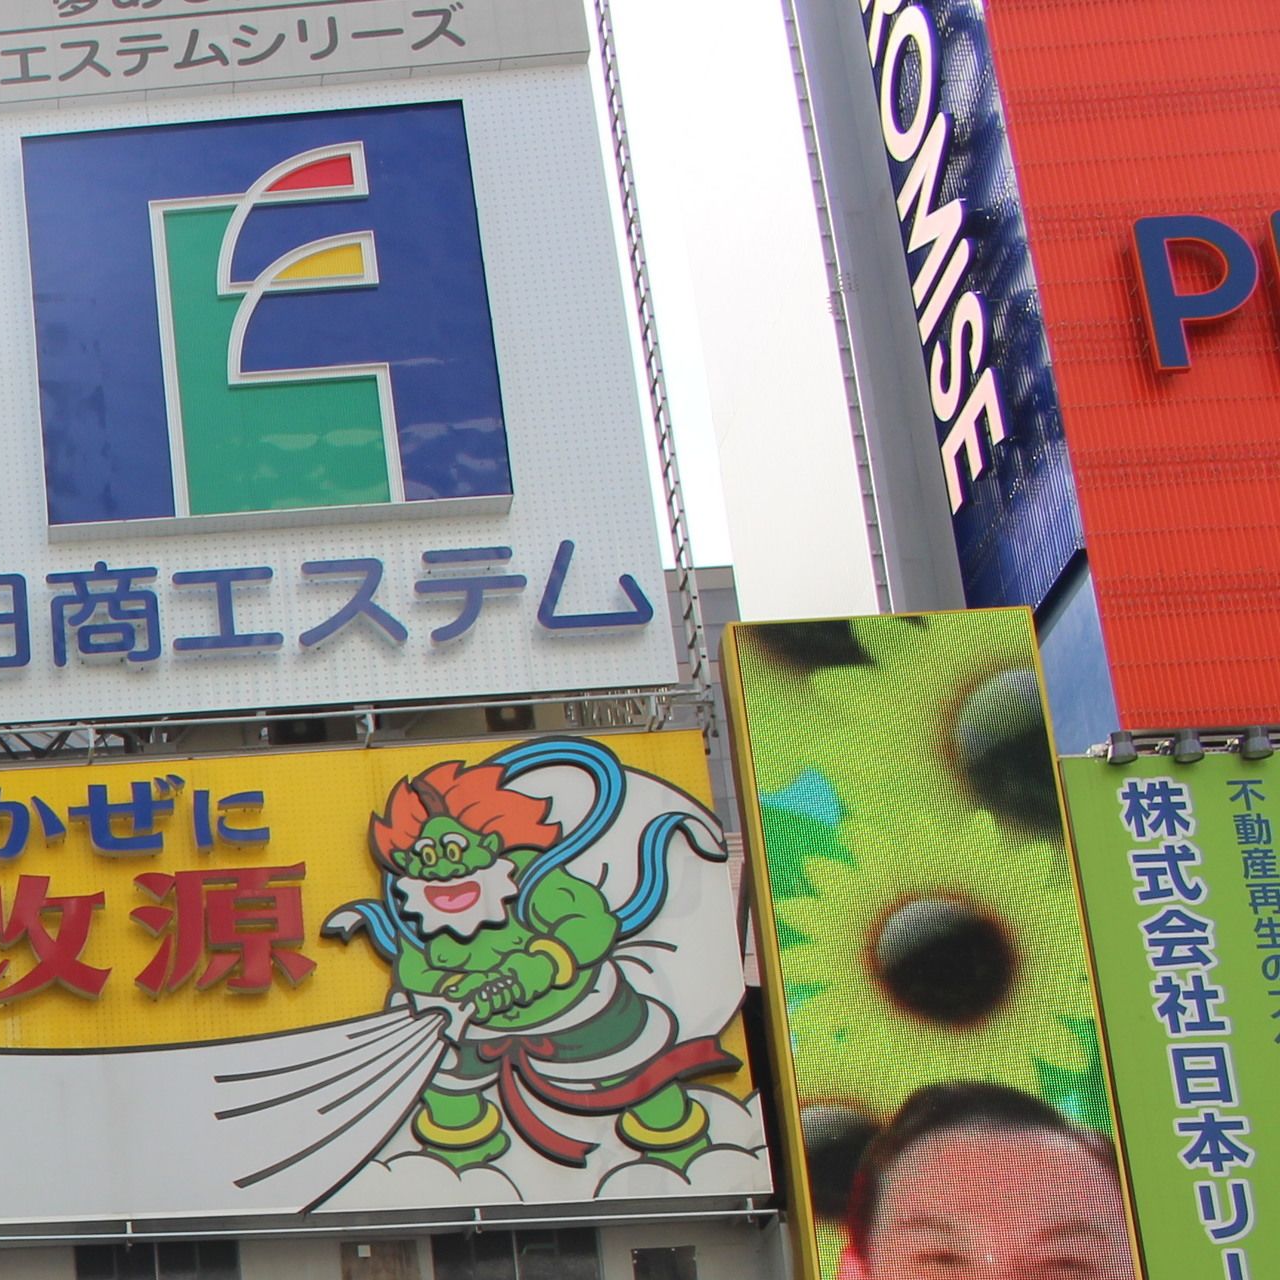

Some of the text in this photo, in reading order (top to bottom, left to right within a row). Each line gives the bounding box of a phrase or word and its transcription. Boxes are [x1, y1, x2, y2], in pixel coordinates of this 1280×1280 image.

[0, 5, 465, 85] エステムシリーズ
[1134, 210, 1280, 374] P
